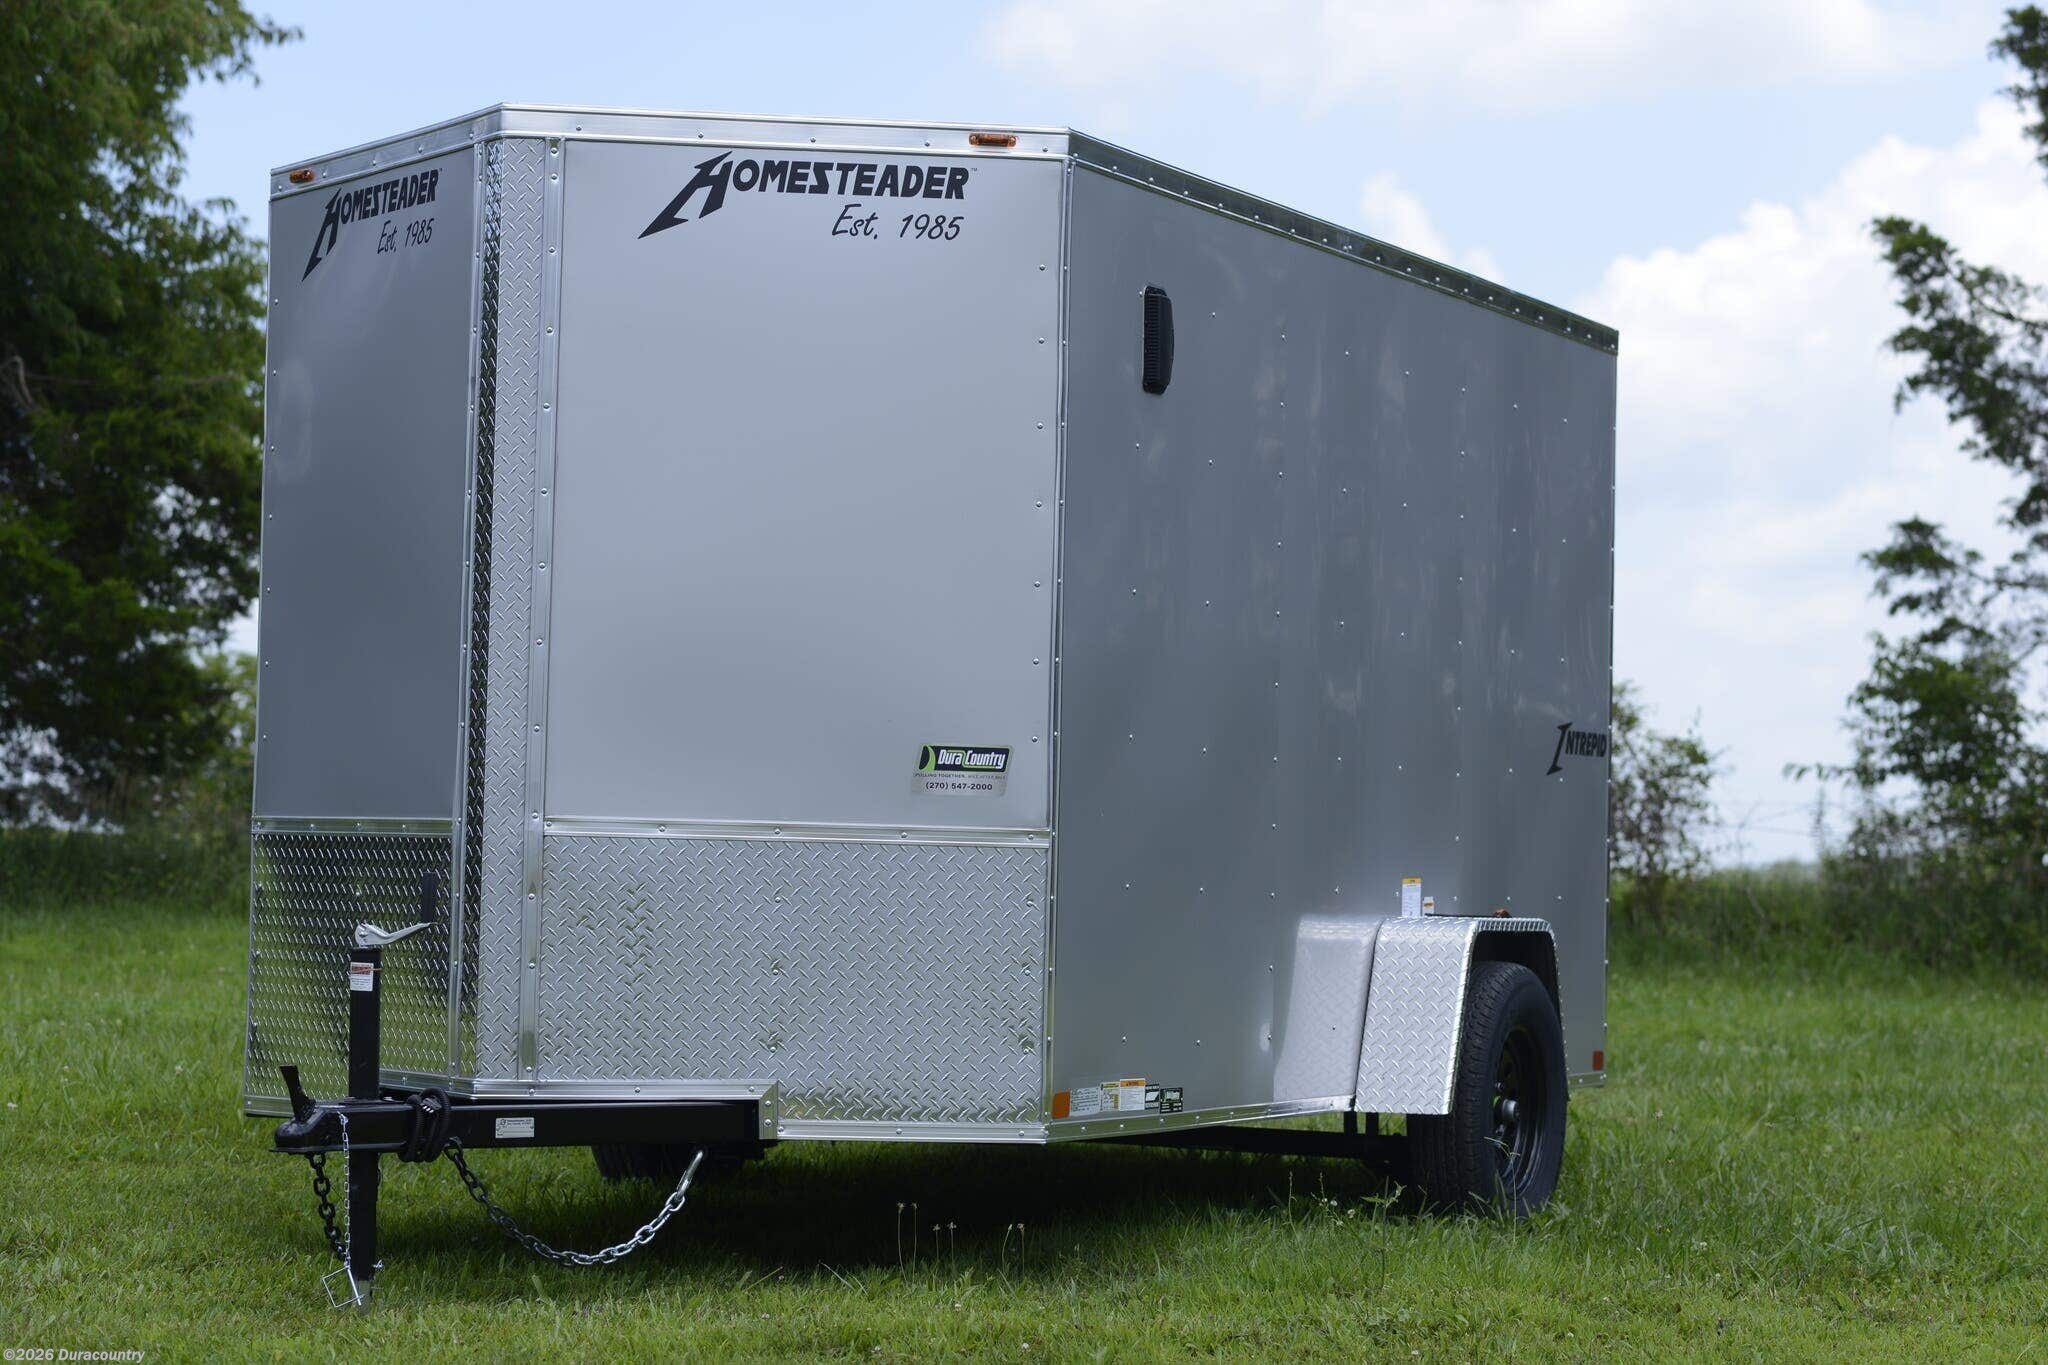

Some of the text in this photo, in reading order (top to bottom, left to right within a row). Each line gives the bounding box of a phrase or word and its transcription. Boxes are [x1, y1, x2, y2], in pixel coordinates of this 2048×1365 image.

[638, 150, 970, 239] HOMESTEADER
[302, 170, 439, 282] HOMESTEADER
[377, 218, 435, 254] Est. 1985
[832, 203, 965, 241] Est. 1985
[937, 749, 1006, 770] Dura Country
[1546, 722, 1607, 776] INTREPID
[925, 781, 993, 791] (270) 547-2000
